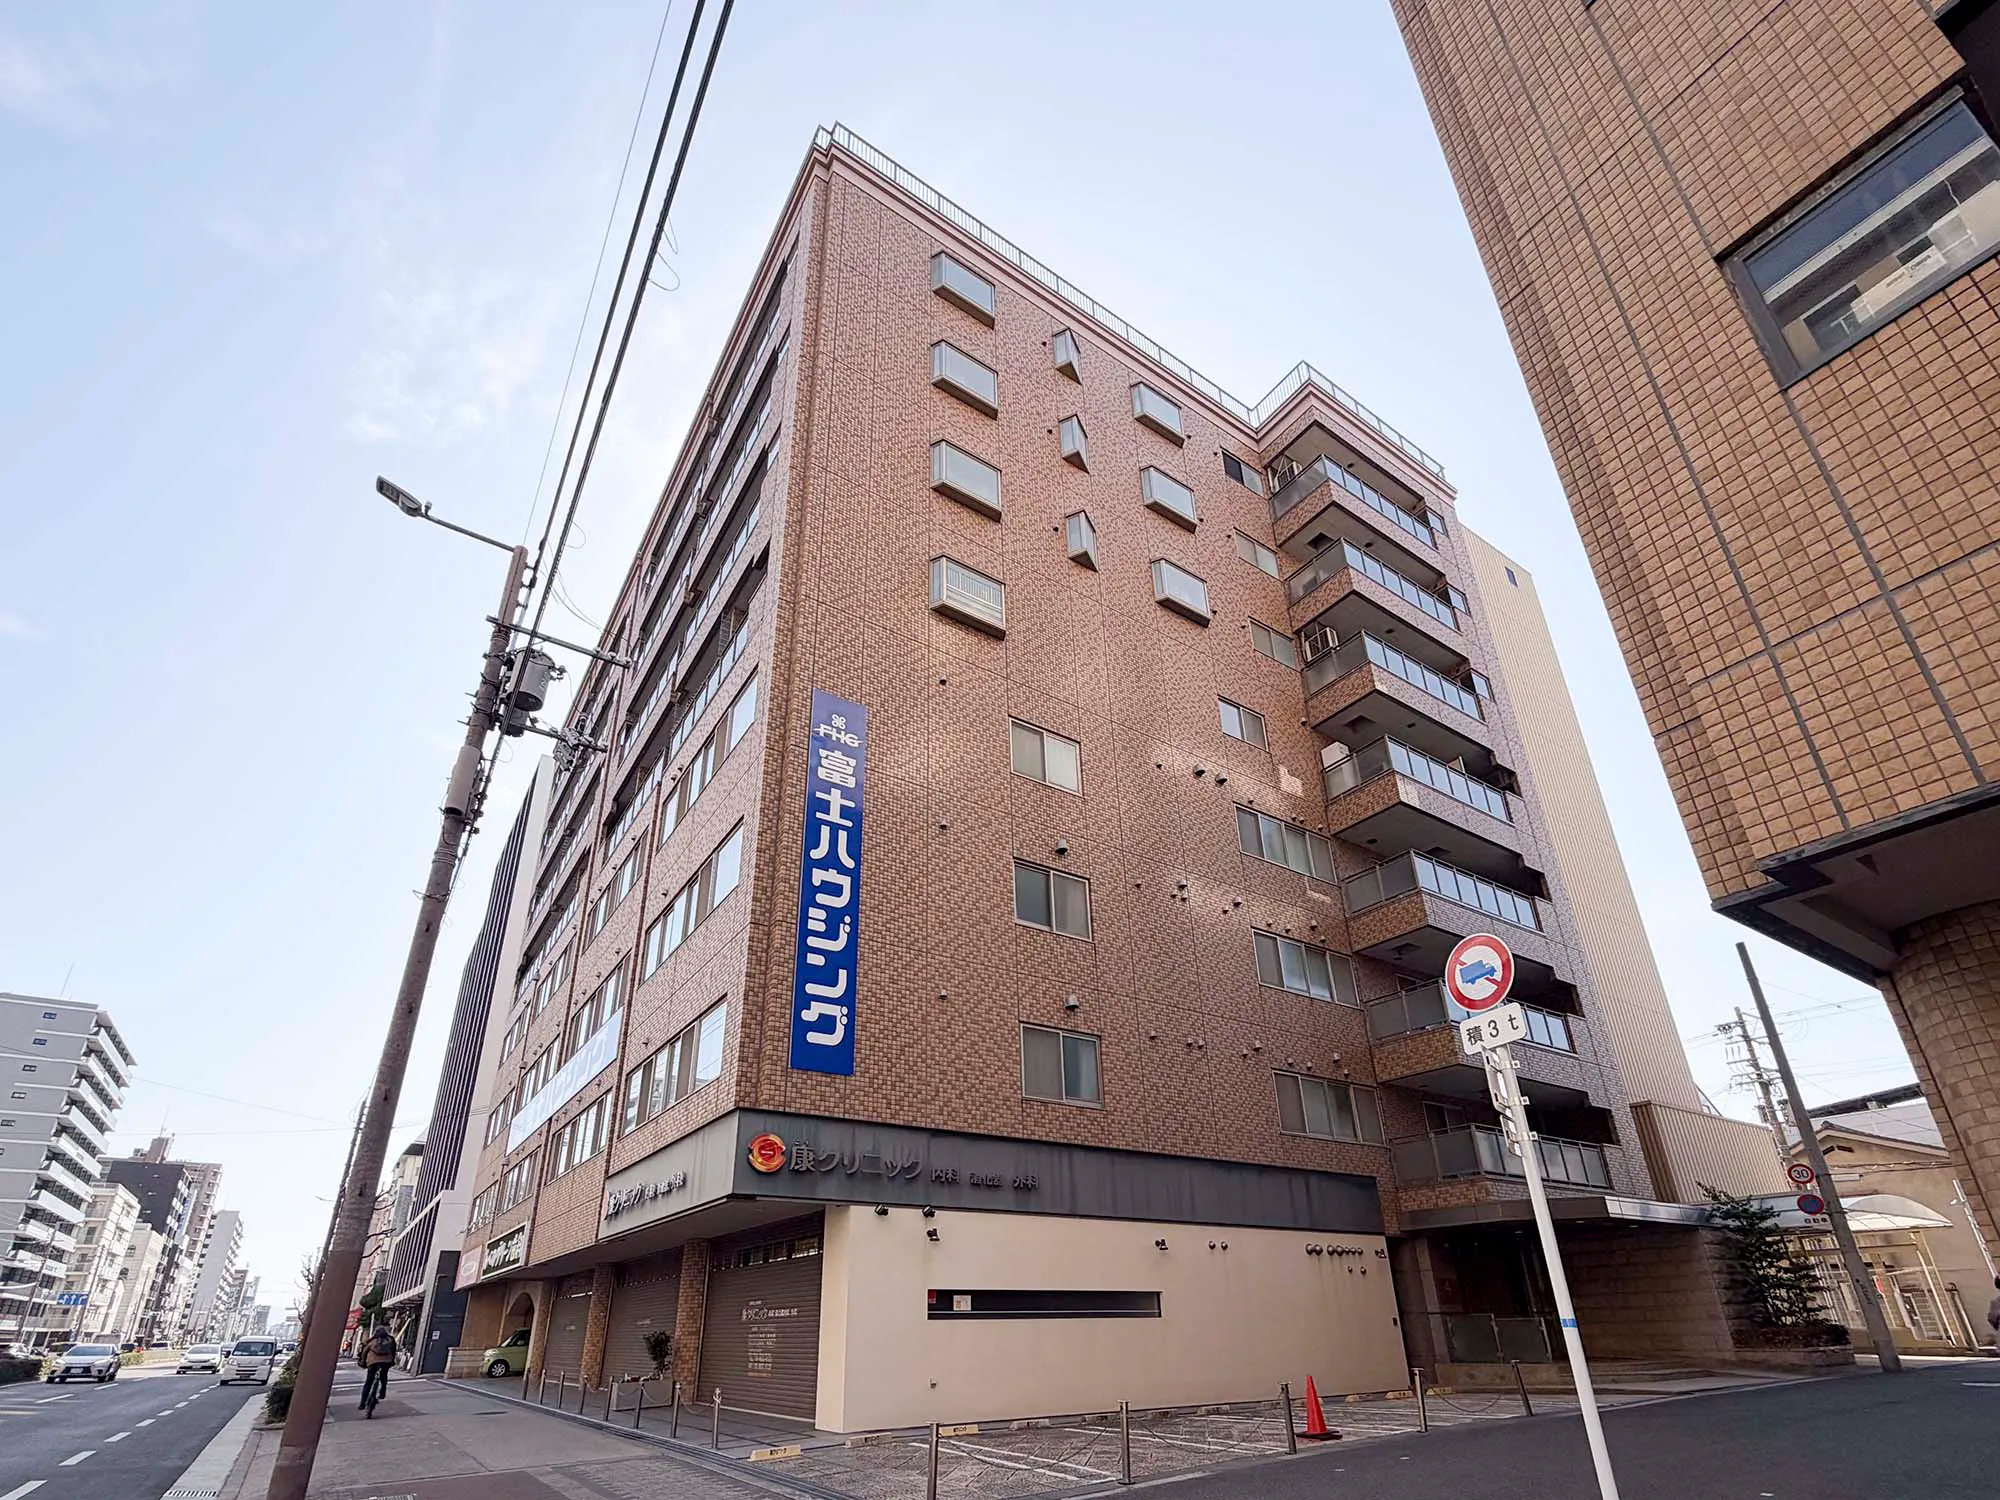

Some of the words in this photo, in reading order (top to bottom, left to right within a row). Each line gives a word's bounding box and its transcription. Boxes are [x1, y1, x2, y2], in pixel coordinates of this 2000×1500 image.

[814, 723, 864, 748] FHG
[801, 748, 857, 1047] 富士ハウジング
[789, 1139, 923, 1180] 康クリニック
[930, 1167, 960, 1184] 内科
[1793, 1169, 1810, 1180] 30
